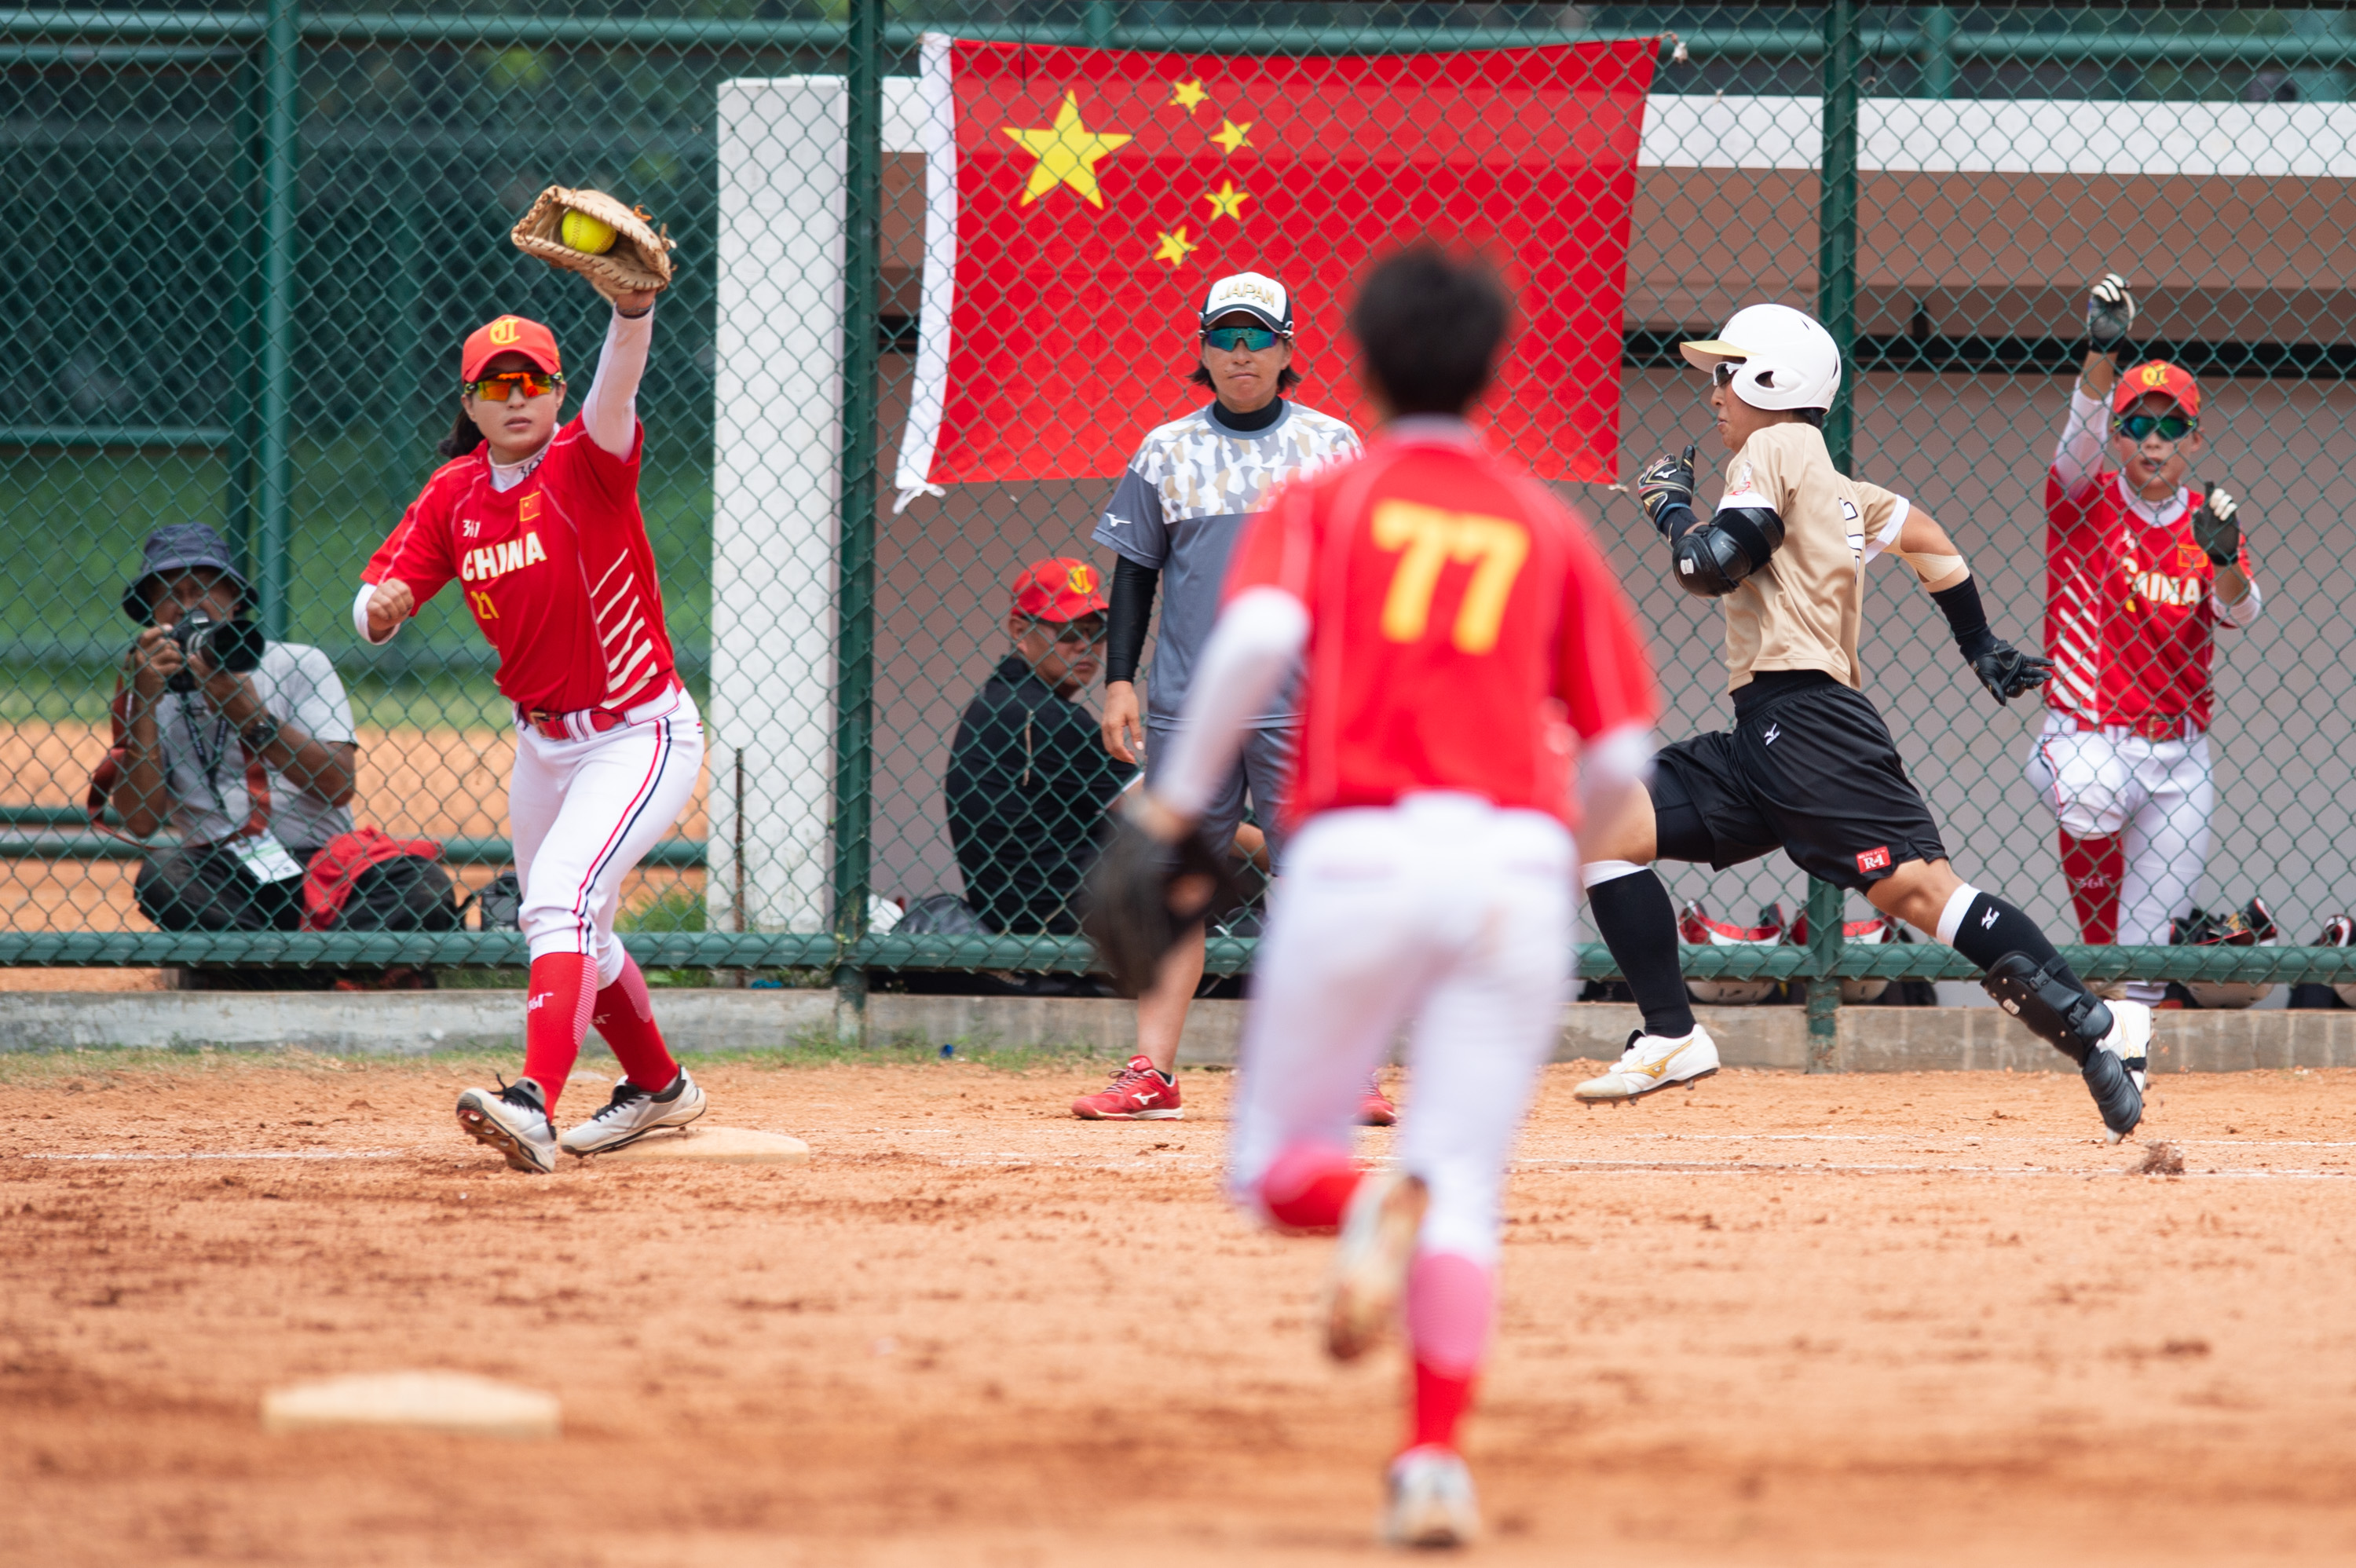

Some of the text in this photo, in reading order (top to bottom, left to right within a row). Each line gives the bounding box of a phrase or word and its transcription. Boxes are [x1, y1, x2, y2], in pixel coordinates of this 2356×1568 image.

[1219, 283, 1275, 308] JAPAN
[462, 531, 548, 582] CHINA
[1372, 498, 1531, 657] 77
[470, 590, 500, 620] 21
